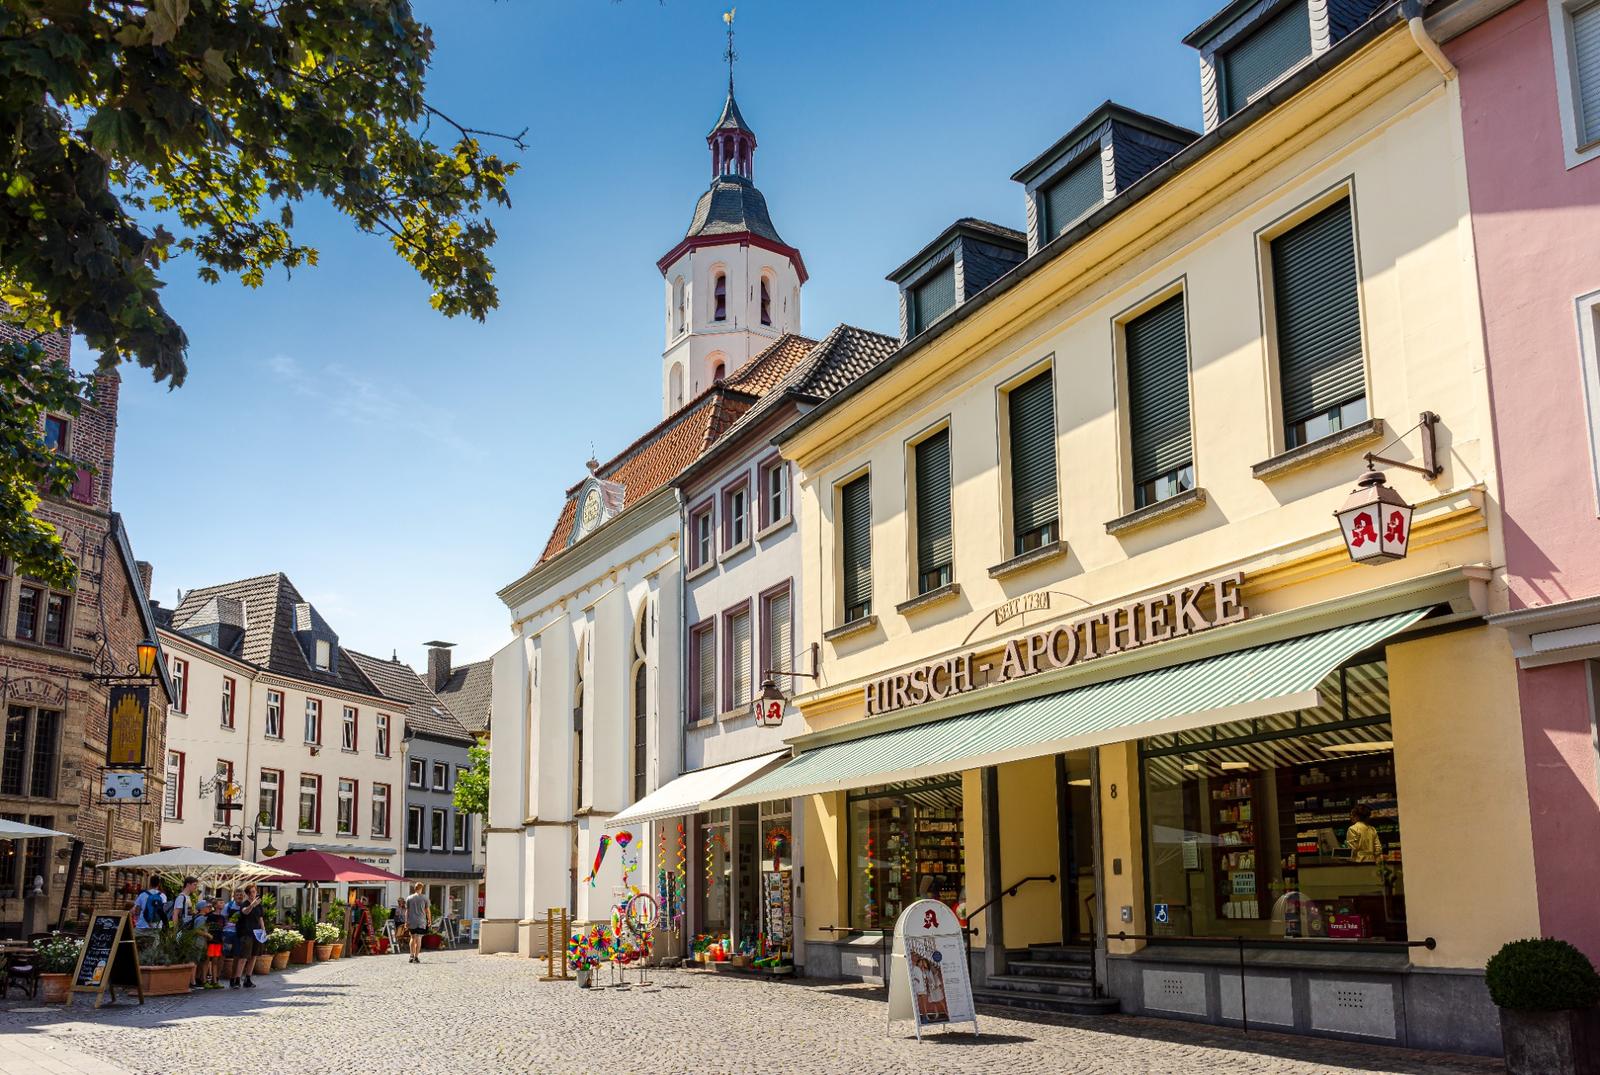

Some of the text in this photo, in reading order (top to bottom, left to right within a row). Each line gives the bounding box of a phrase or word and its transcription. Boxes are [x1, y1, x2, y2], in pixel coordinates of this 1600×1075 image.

[997, 591, 1046, 623] SEIT 1730
[864, 652, 976, 718] HIRSCH
[998, 571, 1250, 683] APOTHEKE
[1110, 783, 1118, 799] 8
